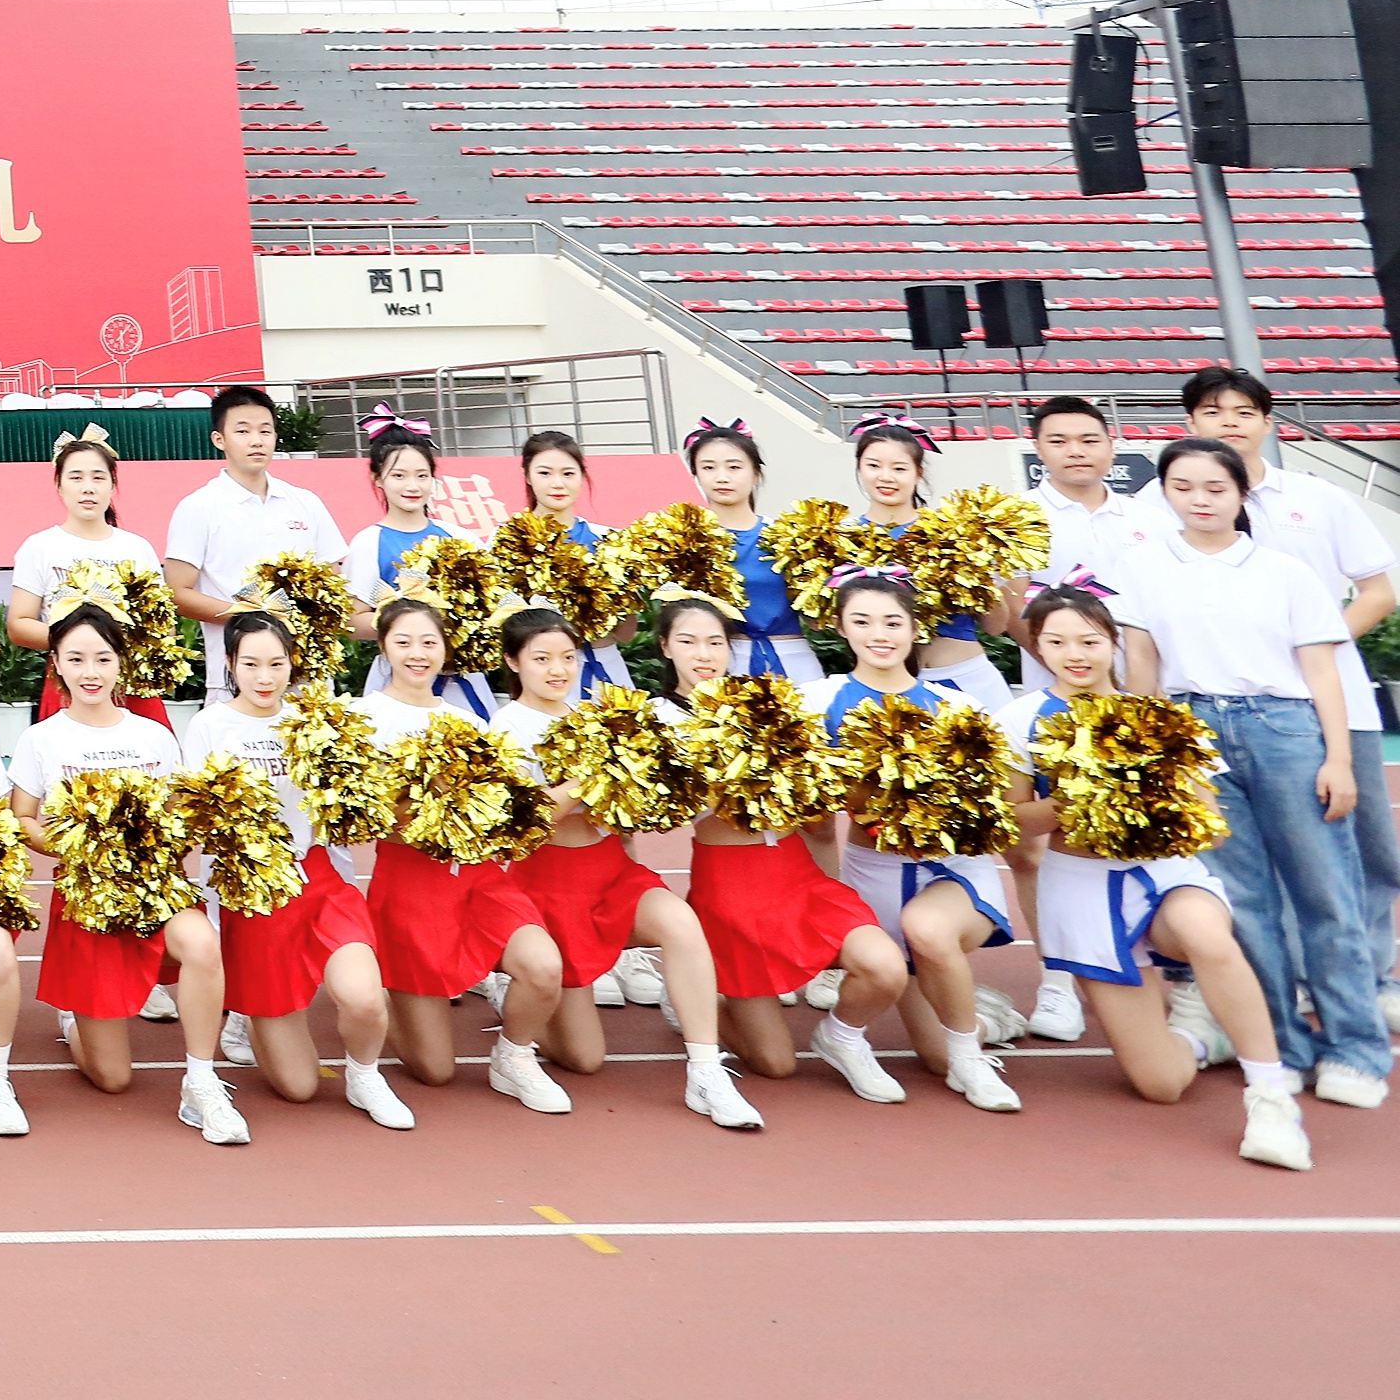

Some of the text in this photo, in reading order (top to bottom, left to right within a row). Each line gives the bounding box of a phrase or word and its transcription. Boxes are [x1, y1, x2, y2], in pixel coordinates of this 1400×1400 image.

[366, 267, 444, 293] 西1口
[384, 302, 432, 316] West 1
[241, 740, 284, 752] NATION
[82, 749, 141, 761] NATIONAL
